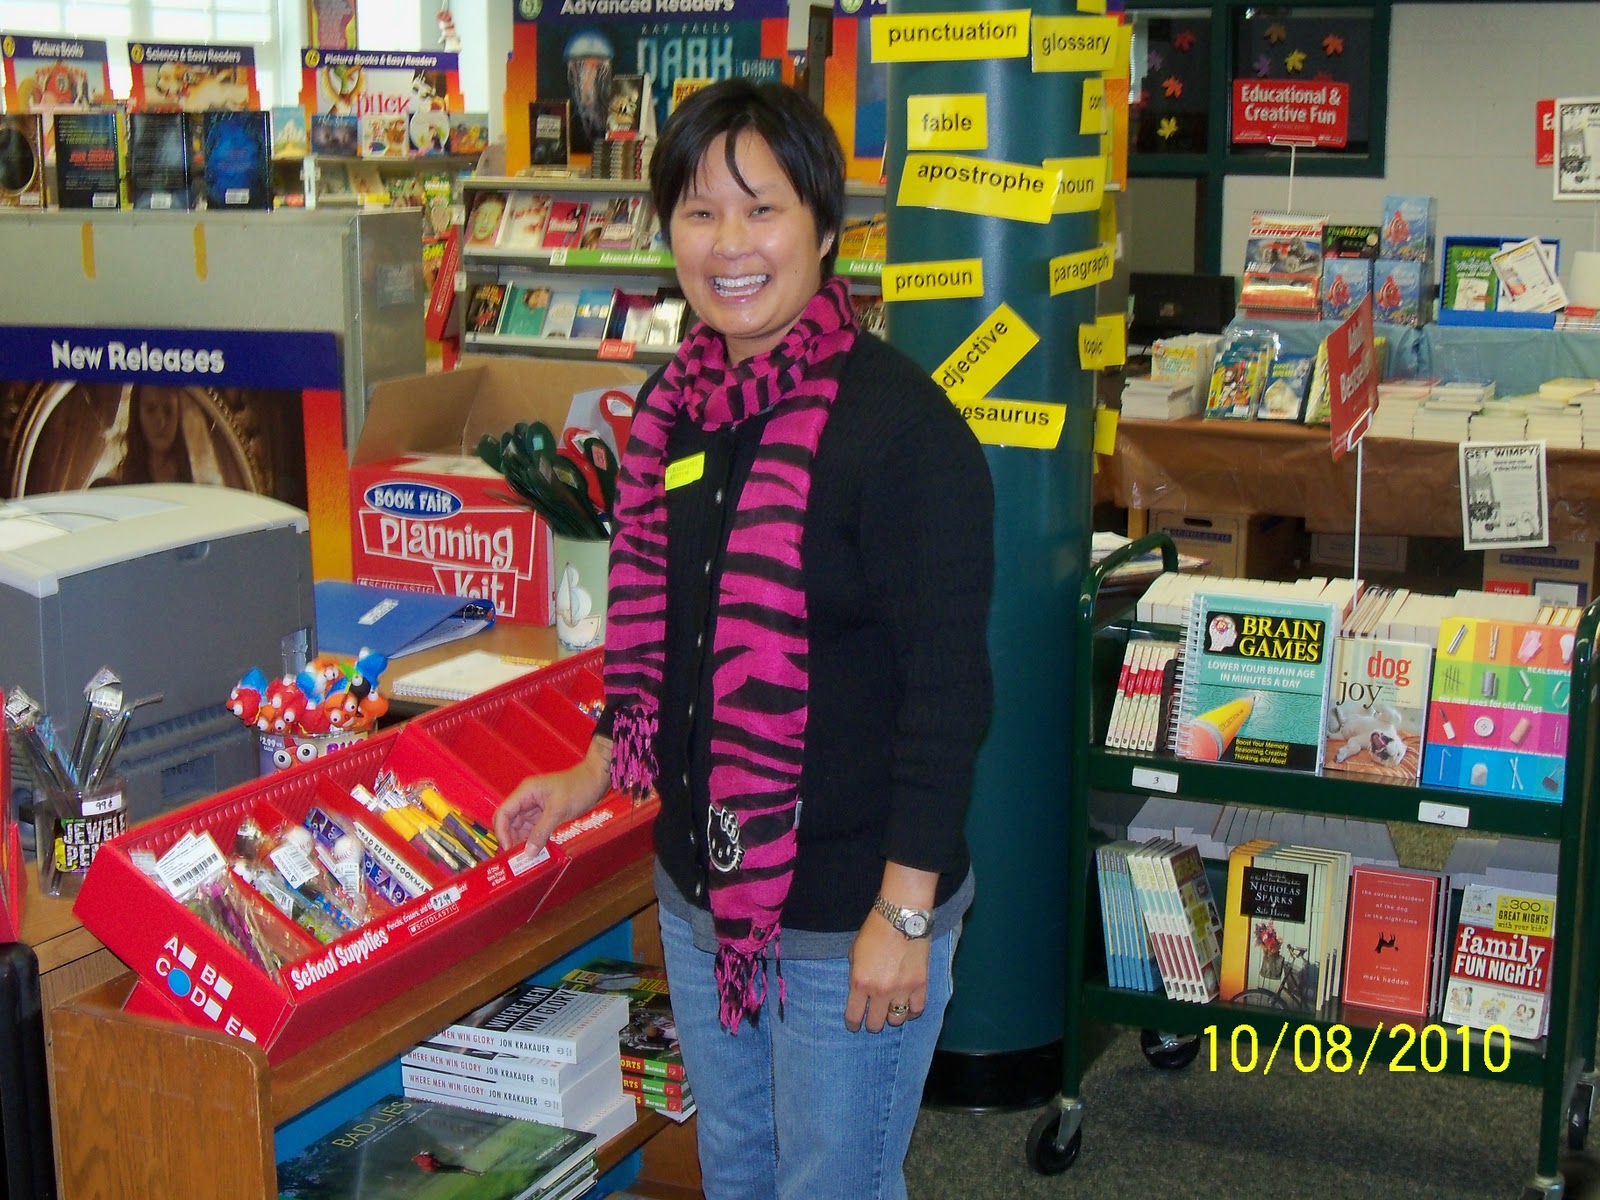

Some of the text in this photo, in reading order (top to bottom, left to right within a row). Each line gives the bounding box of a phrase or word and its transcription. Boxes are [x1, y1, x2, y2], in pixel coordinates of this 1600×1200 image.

[561, 0, 648, 15] Advanced
[640, 22, 669, 36] KAT
[888, 21, 1018, 47] punctuation
[32, 39, 61, 56] Picture
[61, 42, 85, 58] Books
[1041, 33, 1111, 55] glossary
[146, 47, 180, 62] Science
[187, 49, 207, 64] Easy
[207, 49, 241, 63] Readers
[325, 53, 353, 65] Picture
[354, 54, 380, 66] Books
[379, 54, 386, 65] &
[386, 54, 405, 67] Easy
[405, 54, 438, 67] Readers
[1240, 83, 1342, 106] Educational &
[922, 113, 973, 132] fable
[1244, 104, 1337, 125] Creative Fun
[917, 162, 1044, 194] apostrophe
[1053, 252, 1110, 282] paragraph
[895, 269, 973, 294] pronoun
[51, 340, 225, 374] New Releases
[942, 319, 1008, 391] djective
[1083, 336, 1103, 358] topic
[956, 402, 1050, 427] esaurus
[374, 487, 415, 511] BOOK
[379, 516, 513, 571] Planning
[368, 581, 432, 594] SCHOLASTIC
[454, 570, 505, 613] Kit
[1241, 614, 1322, 641] BRAIN
[1238, 636, 1320, 663] GAMES
[1208, 660, 1316, 679] LOWER YOUR BRAIN AGE
[1367, 650, 1412, 687] dog
[1220, 673, 1231, 682] IN
[1231, 674, 1272, 686] MINUTES
[1281, 680, 1301, 689] DAY
[1336, 671, 1384, 710] joy
[1470, 699, 1488, 707] uses
[1488, 699, 1502, 708] for
[1502, 701, 1516, 709] old
[1516, 702, 1543, 714] things
[1235, 738, 1250, 747] Boost
[1264, 748, 1288, 757] Creative
[1259, 756, 1270, 764] and
[1270, 757, 1287, 765] More!
[1152, 776, 1160, 785] 3
[1437, 810, 1446, 820] 2
[63, 813, 127, 845] JEWELE
[549, 810, 614, 845] School Supplies
[374, 844, 395, 866] BEADS
[1250, 881, 1301, 896] NICHOLAS
[1255, 892, 1293, 905] SPARKS
[1373, 891, 1397, 899] curious
[1398, 894, 1425, 903] incident
[420, 904, 429, 914] and
[1255, 906, 1291, 918] Safe Haven
[1509, 899, 1541, 912] 300
[416, 904, 458, 930] SCHOLASTIC
[1497, 921, 1512, 929] with
[1513, 924, 1529, 932] your
[1498, 910, 1549, 925] GREAT NIGHTS
[163, 936, 179, 957] A
[1457, 925, 1546, 970] family
[155, 957, 171, 977] C
[290, 926, 390, 992] School Supplies
[200, 964, 217, 986] B
[1362, 973, 1409, 986] mark haddon
[1454, 954, 1543, 988] FUN NIGHT!
[190, 985, 207, 1007] D
[485, 986, 555, 1029] WHERE MEN
[511, 988, 579, 1033] WIN GLORY
[224, 1016, 241, 1037] E
[442, 1030, 551, 1054] MEN WIN GLORY JON KRAKAUER
[407, 1052, 535, 1083] WHERE MEN WIN GLORY JON KRAKAUER
[621, 1059, 641, 1070] ORTS
[408, 1074, 538, 1106] WHERE MEN WIN GLORY JON KRAKAUER
[623, 1079, 639, 1089] RTS
[331, 1122, 377, 1148] BAD
[369, 1101, 412, 1123] LIES
